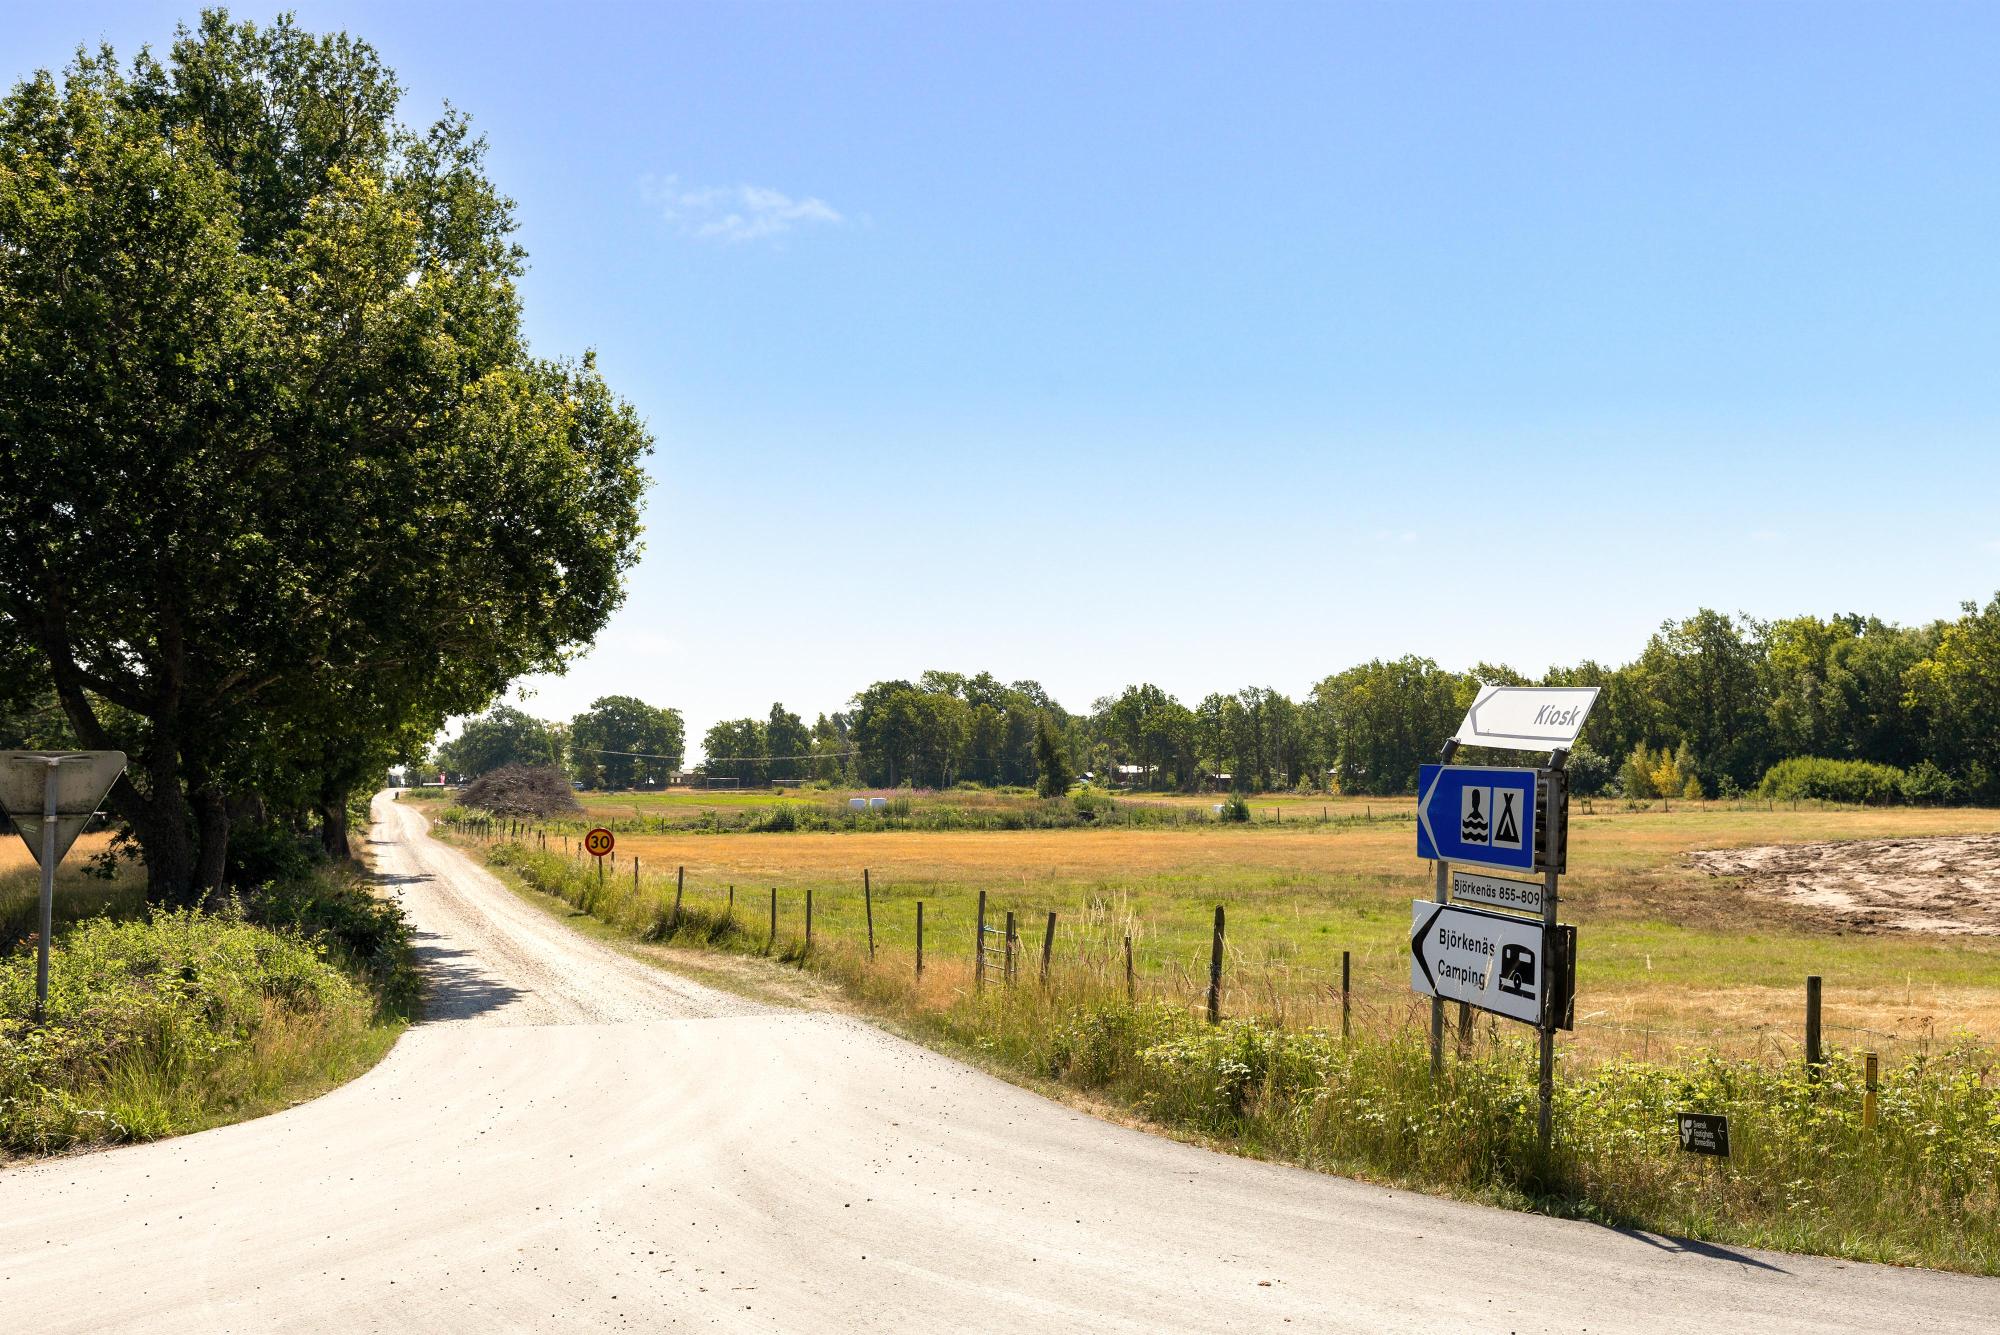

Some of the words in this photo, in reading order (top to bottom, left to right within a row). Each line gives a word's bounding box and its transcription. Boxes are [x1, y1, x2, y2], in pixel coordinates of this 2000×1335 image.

[1533, 704, 1581, 726] Kiosk
[590, 835, 610, 849] 30
[1454, 879, 1496, 898] Björkenäs
[1499, 886, 1540, 906] 855-809
[1439, 928, 1495, 957] Björkenäs
[1438, 959, 1486, 991] Camping
